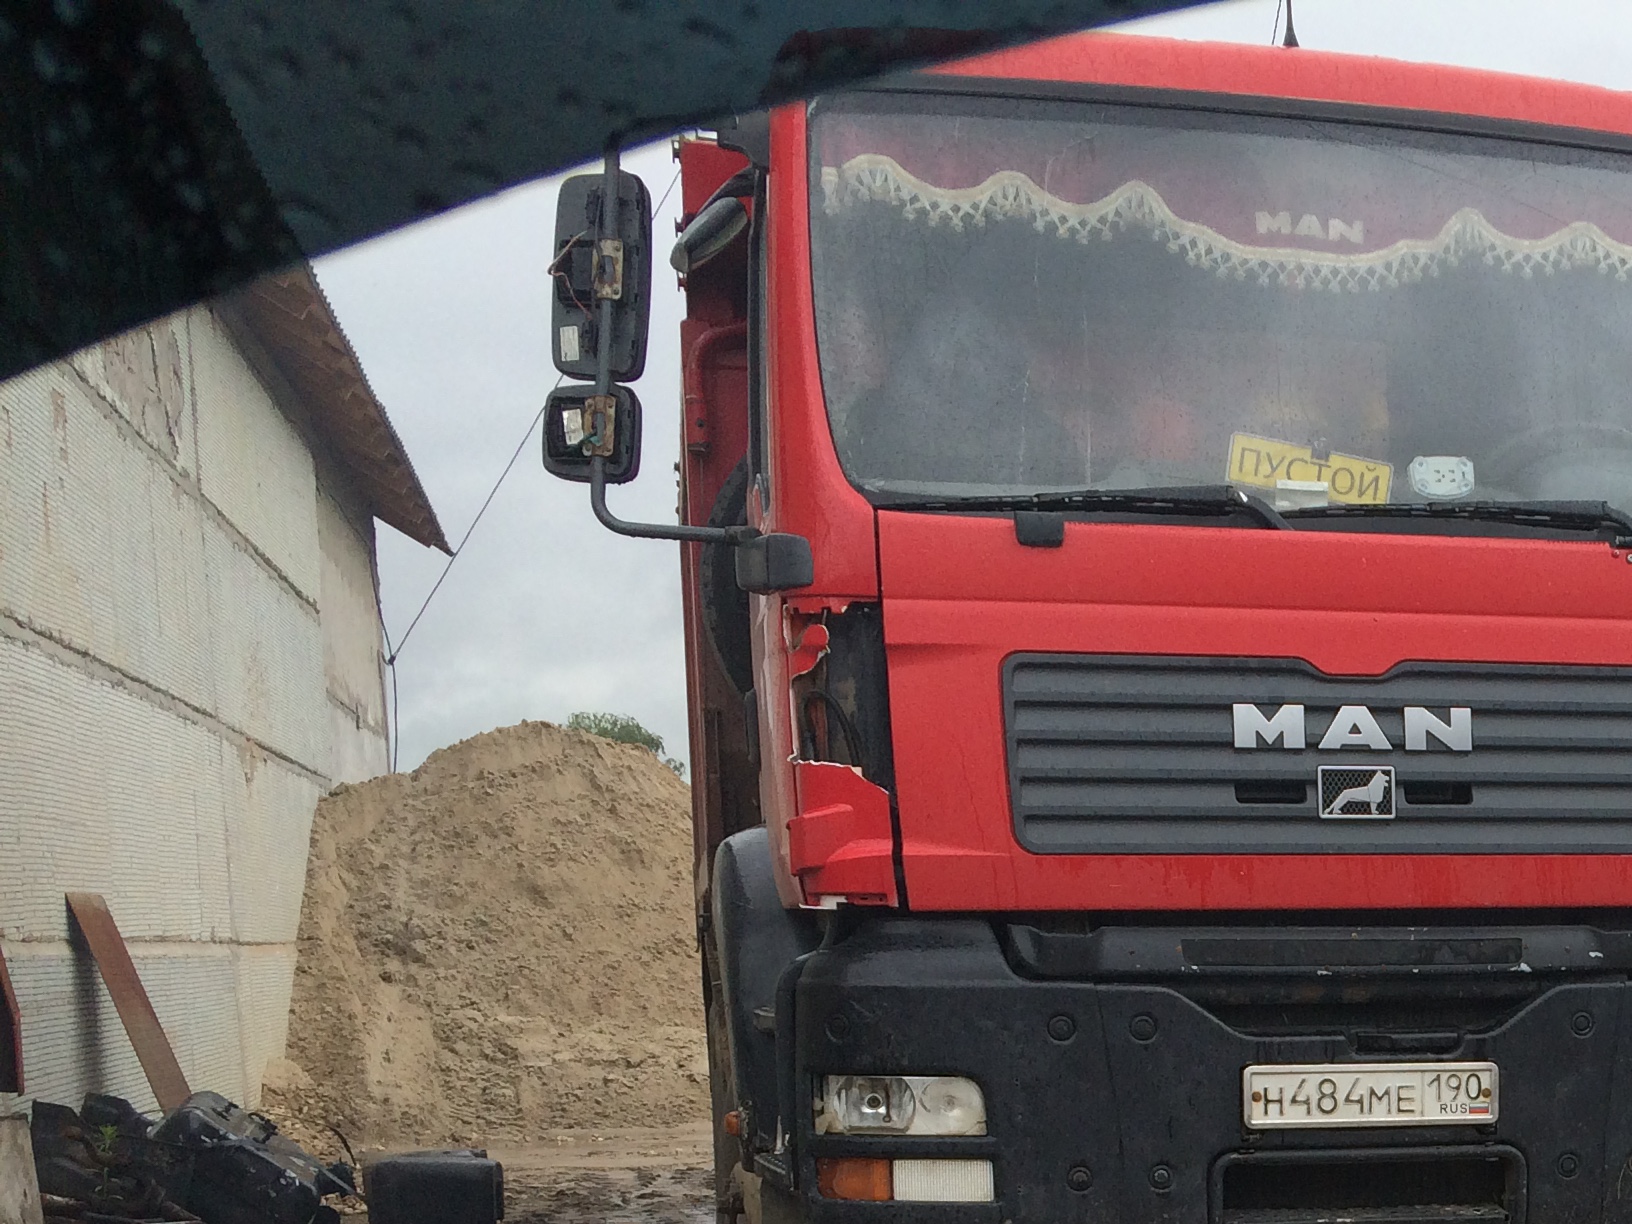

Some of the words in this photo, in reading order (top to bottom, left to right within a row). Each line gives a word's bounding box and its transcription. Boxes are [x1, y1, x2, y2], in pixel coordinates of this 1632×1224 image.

[1255, 211, 1364, 244] MAN
[1238, 446, 1381, 501] ПУСТОЙ
[1233, 703, 1473, 751] MAN
[1427, 1073, 1482, 1102] 190
[1440, 1103, 1468, 1114] RUS
